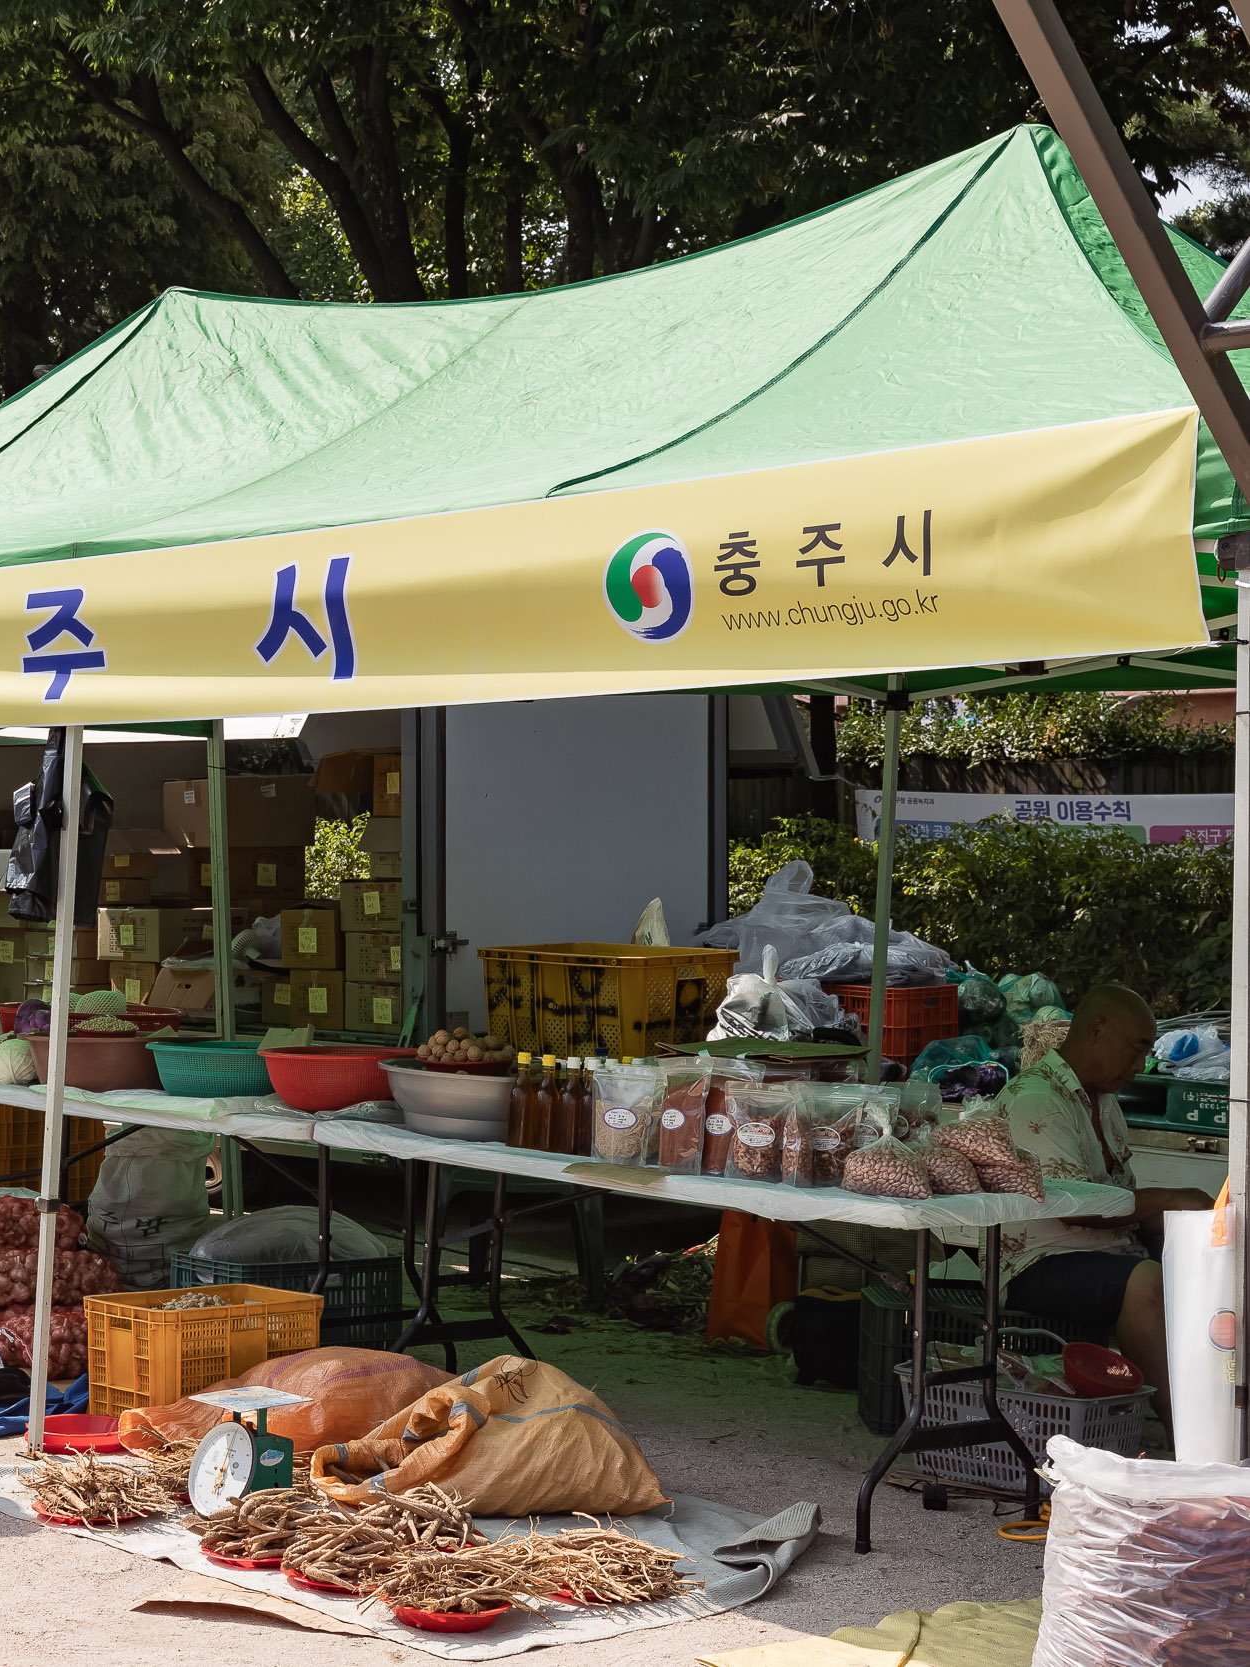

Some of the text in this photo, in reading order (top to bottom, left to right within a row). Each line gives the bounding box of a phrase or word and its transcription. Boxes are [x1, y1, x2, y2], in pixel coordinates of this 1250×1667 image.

[721, 589, 939, 631] www.chungju.go.kr
[21, 588, 106, 701] 주
[254, 556, 355, 681] 시
[906, 796, 935, 806] 공원녹지과
[1014, 800, 1132, 822] 공원 이용수칙
